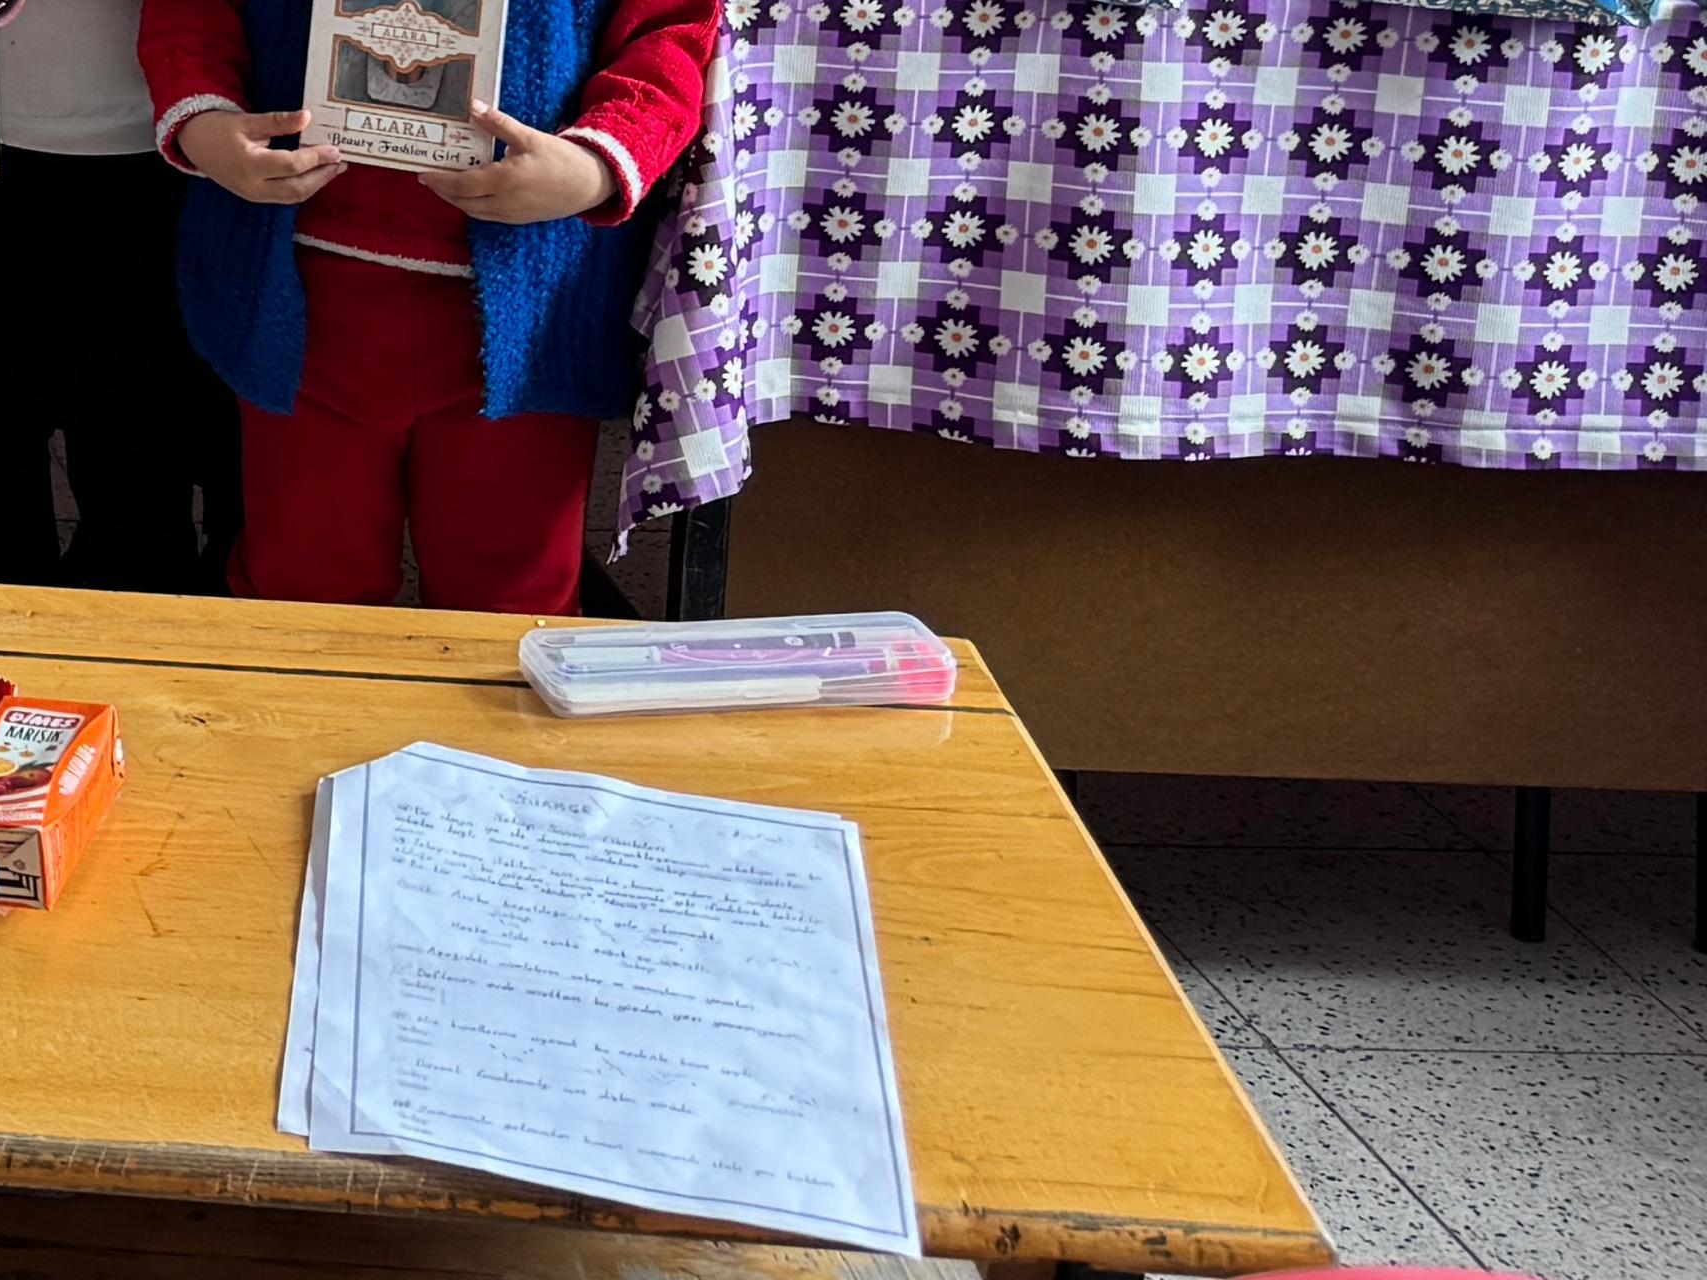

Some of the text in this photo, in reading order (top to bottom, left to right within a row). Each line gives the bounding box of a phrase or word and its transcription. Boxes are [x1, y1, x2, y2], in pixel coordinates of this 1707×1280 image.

[381, 26, 428, 44] ALARA
[360, 114, 429, 139] ALARA
[329, 130, 460, 164] Beauty Fashion Girl
[4, 709, 80, 730] DİMES
[5, 724, 63, 747] KARIŞIK
